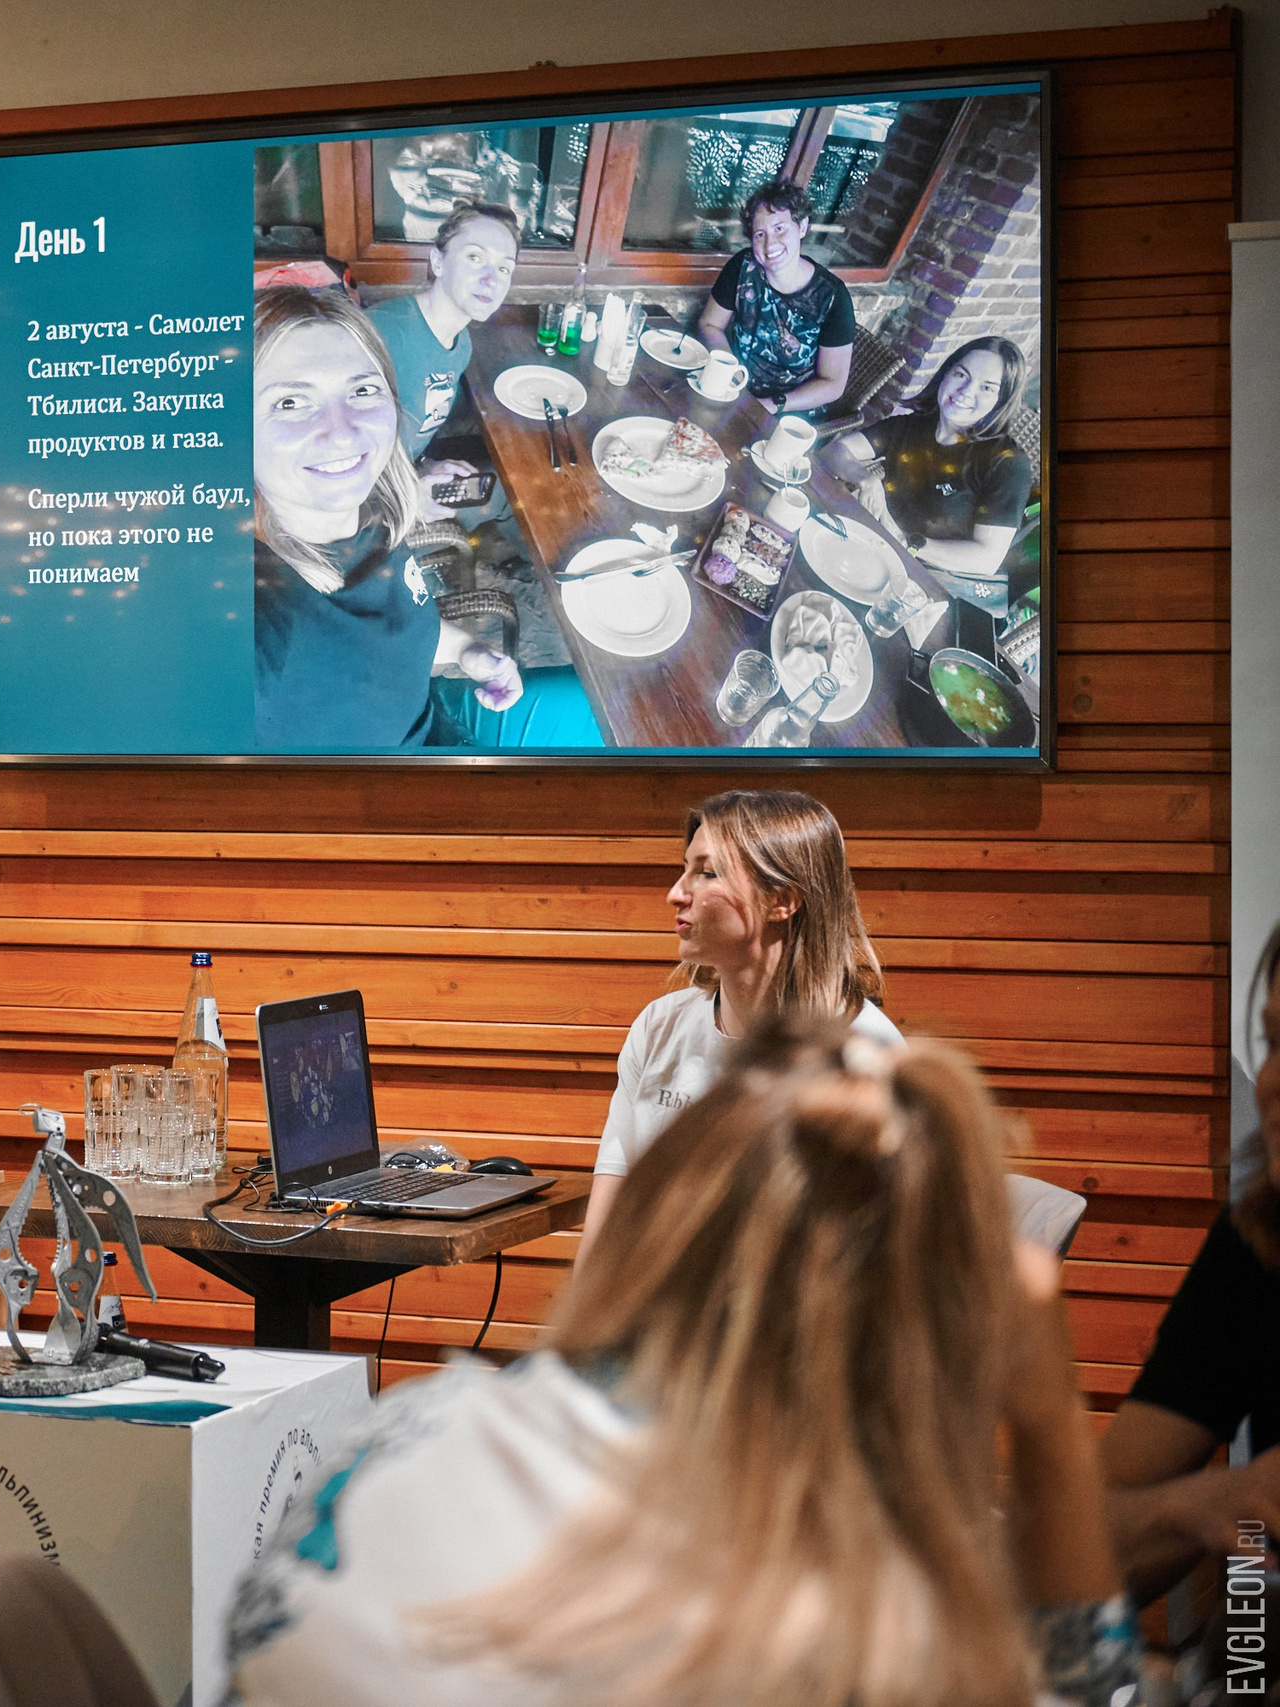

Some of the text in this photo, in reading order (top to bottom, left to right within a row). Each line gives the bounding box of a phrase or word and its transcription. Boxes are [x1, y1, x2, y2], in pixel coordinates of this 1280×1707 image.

[14, 217, 105, 263] День 1
[27, 320, 40, 341] 2
[45, 320, 129, 344] августа
[149, 314, 245, 336] Самолет
[27, 351, 219, 379] Санкт-Петербург
[27, 391, 224, 416] Тбилиси. Закупка
[28, 431, 224, 458] продуктов и газа.
[28, 483, 251, 513] Сперли чужой баул,
[28, 526, 214, 547] но пока этого не
[28, 565, 140, 584] понимаем
[260, 1441, 285, 1514] премия
[288, 1428, 298, 1448] по
